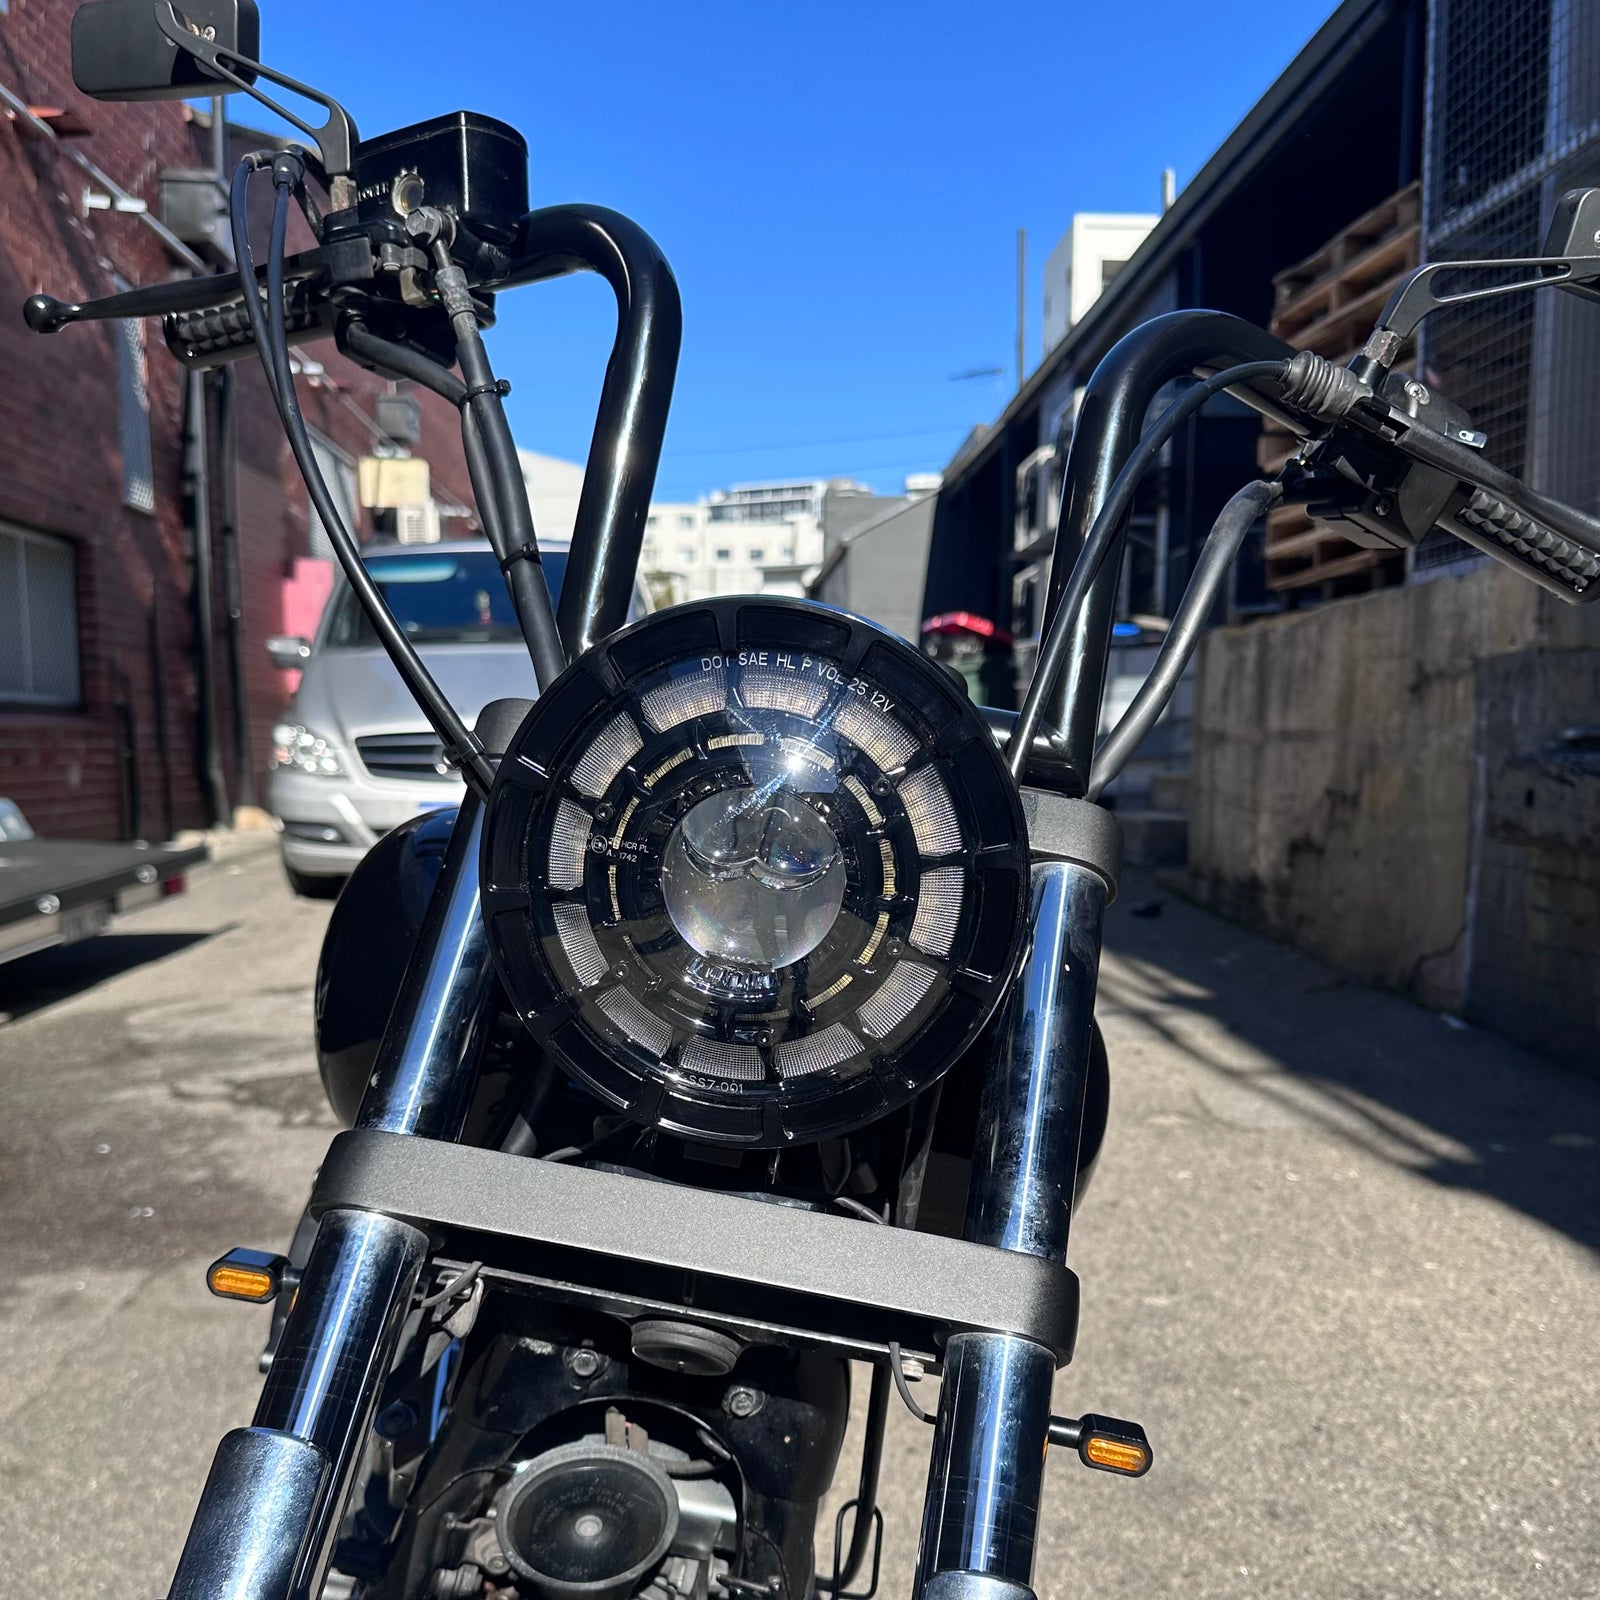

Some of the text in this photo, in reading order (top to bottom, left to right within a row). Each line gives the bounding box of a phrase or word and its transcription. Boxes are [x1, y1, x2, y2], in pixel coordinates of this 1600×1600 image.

[738, 652, 768, 666] SAE
[776, 653, 796, 670] HL
[801, 658, 813, 672] P
[847, 678, 869, 695] 25
[870, 690, 895, 712] 12V
[621, 840, 638, 851] HCR
[639, 844, 650, 853] PL
